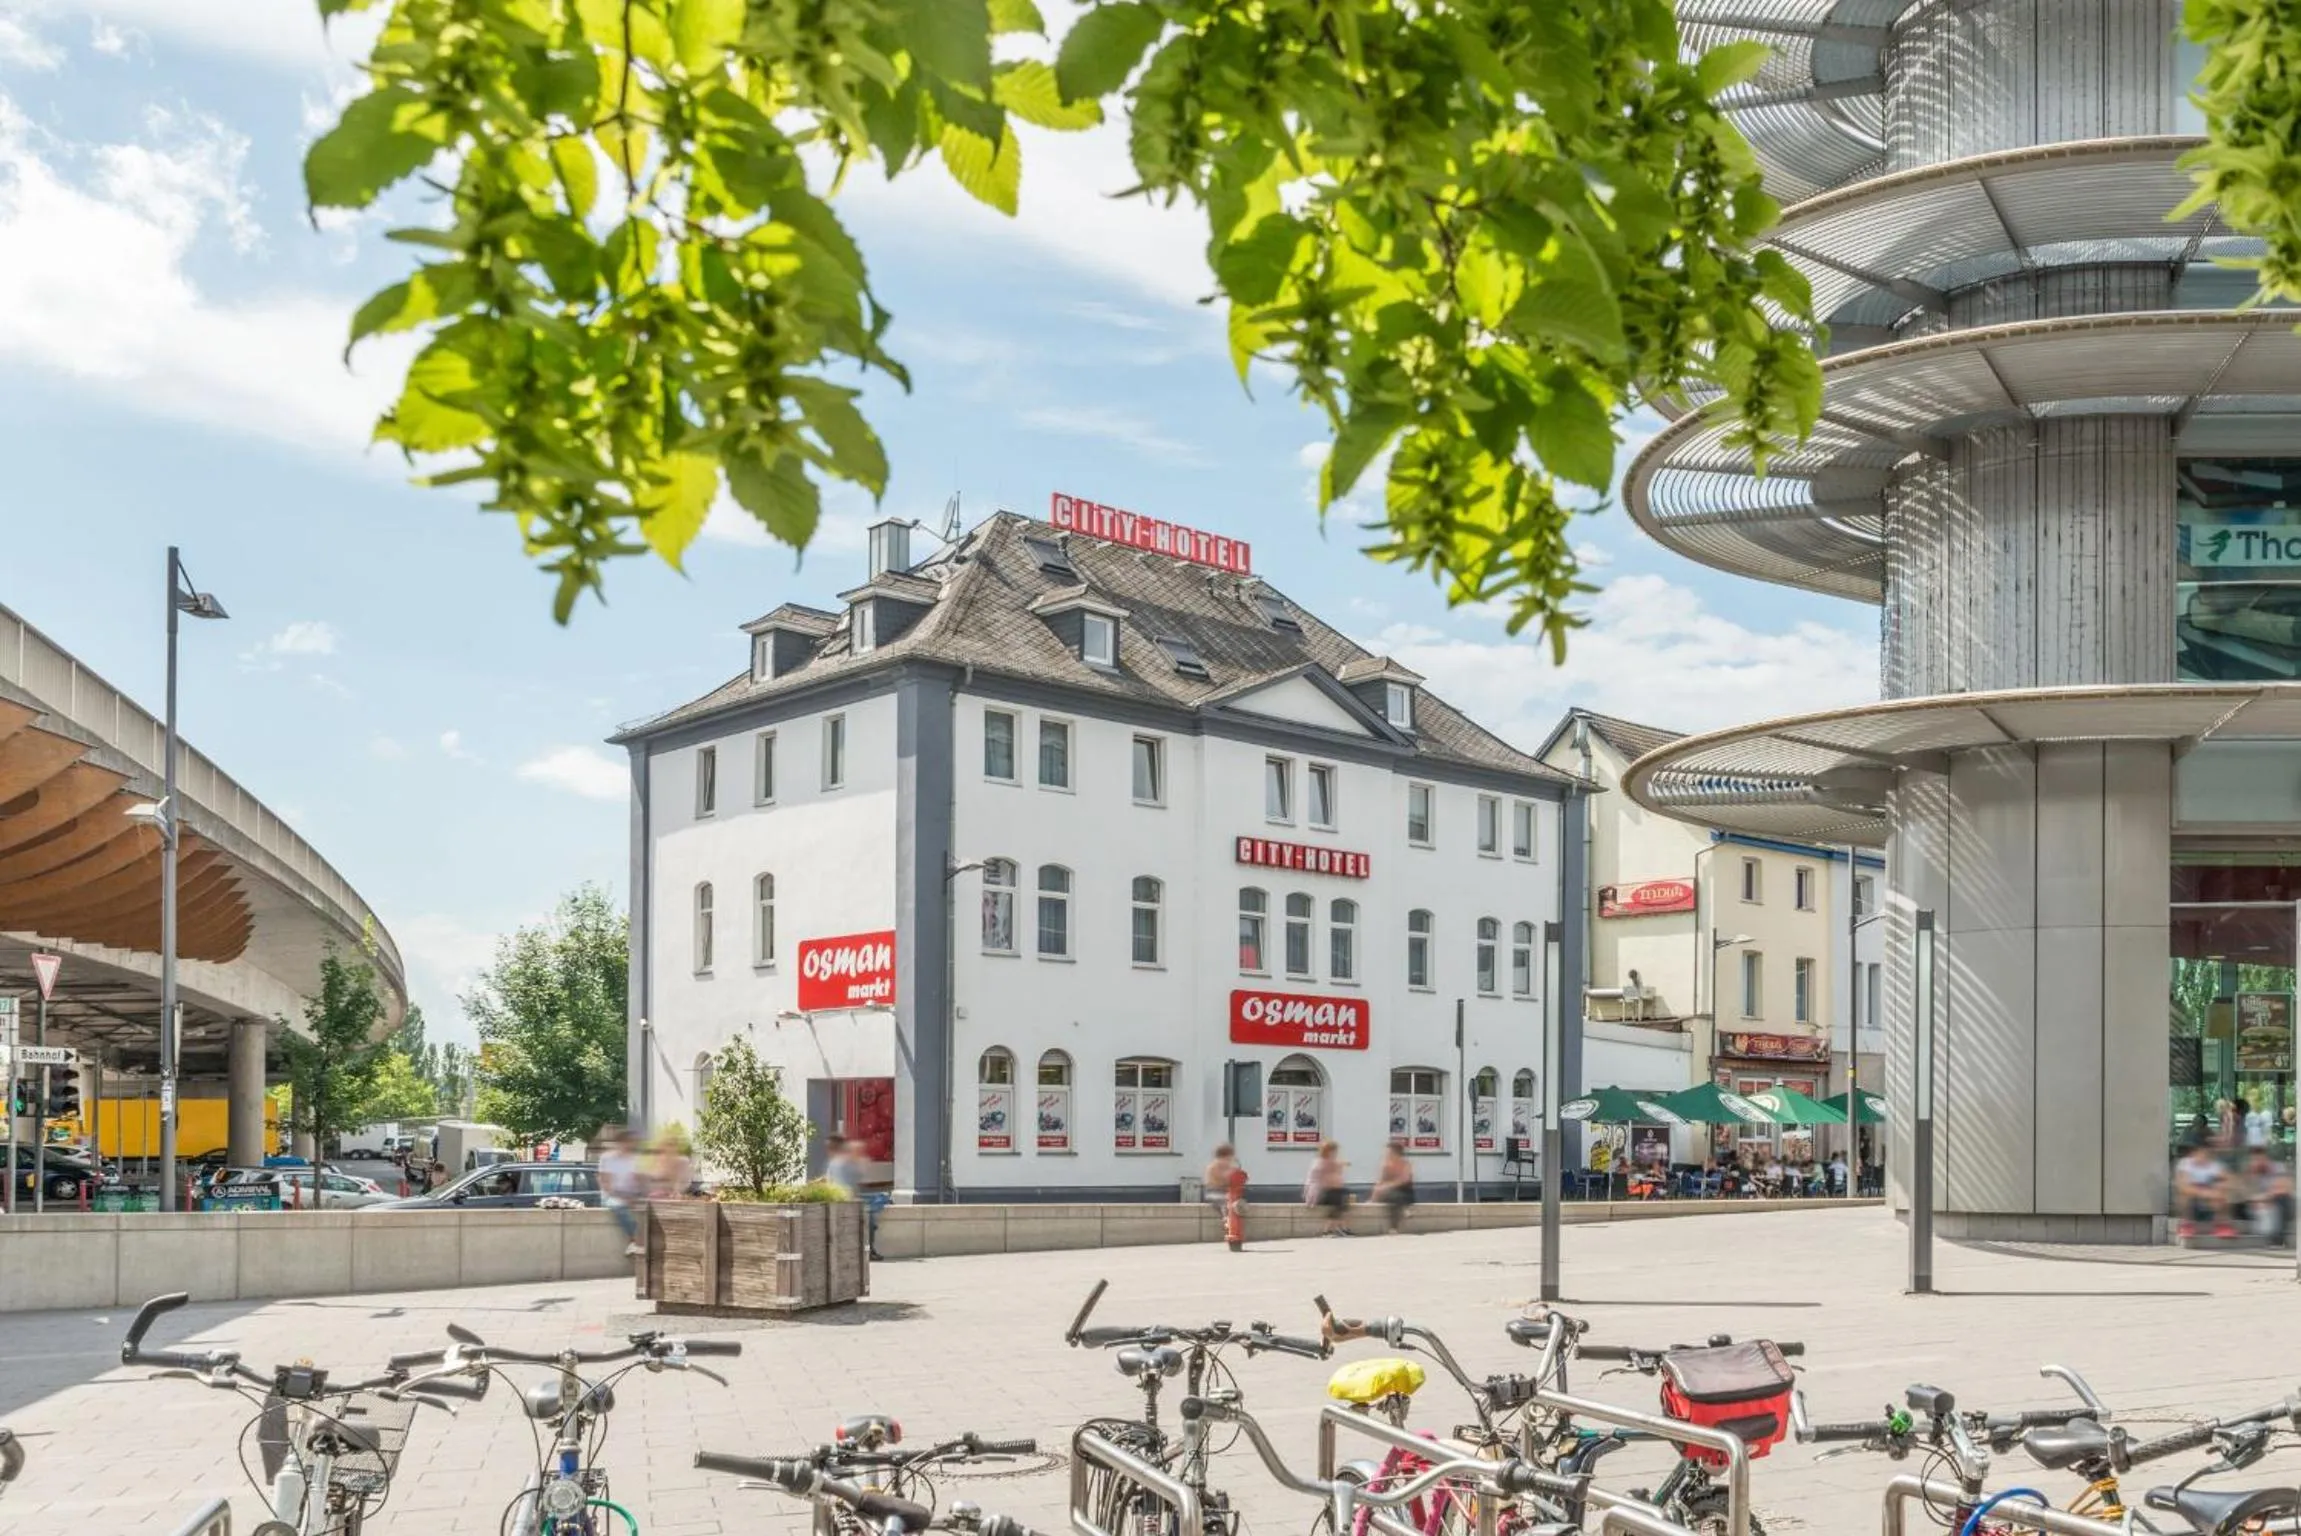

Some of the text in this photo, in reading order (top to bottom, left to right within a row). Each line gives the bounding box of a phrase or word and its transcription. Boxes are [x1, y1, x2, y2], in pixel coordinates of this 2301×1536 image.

[1055, 495, 1248, 571] CITY-HOTEL
[1239, 838, 1368, 876] CITY-HOTEL
[847, 976, 890, 999] markt
[1303, 1029, 1356, 1045] markt
[21, 1049, 61, 1060] Bahnhof
